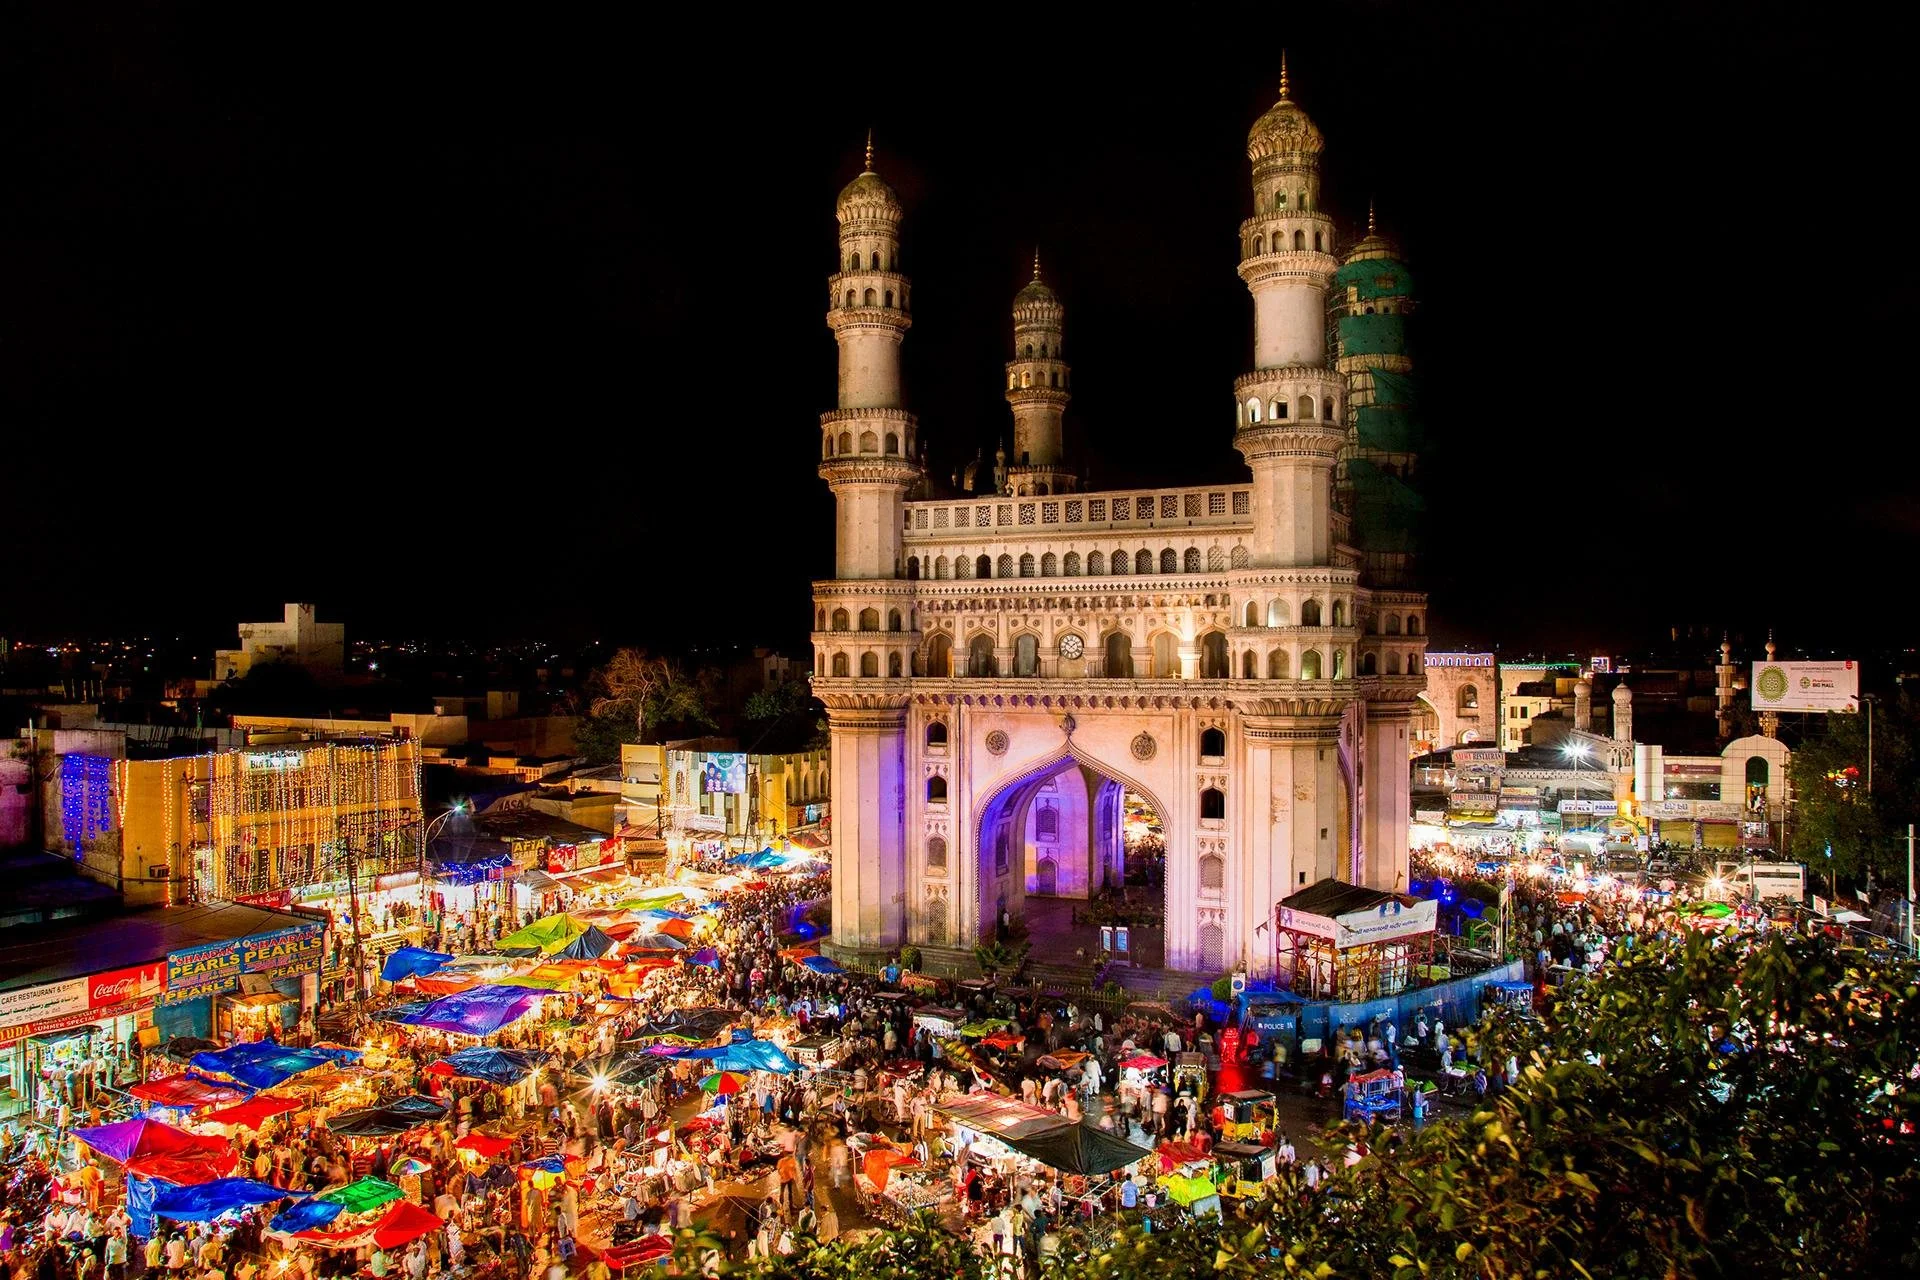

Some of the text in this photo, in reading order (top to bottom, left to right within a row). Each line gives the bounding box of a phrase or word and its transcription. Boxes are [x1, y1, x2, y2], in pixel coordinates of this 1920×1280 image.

[250, 931, 315, 950] SHAADAN
[176, 946, 235, 966] SHAADAN
[244, 938, 322, 963] PEARLS
[170, 954, 240, 979] PEARLS
[272, 959, 320, 978] PEARLS
[1, 995, 18, 1005] CAFE
[19, 987, 56, 1000] RESTAURANT
[165, 977, 236, 1003] PEARLS
[33, 1022, 65, 1032] SUMMER
[67, 1016, 96, 1026] SPECIAL
